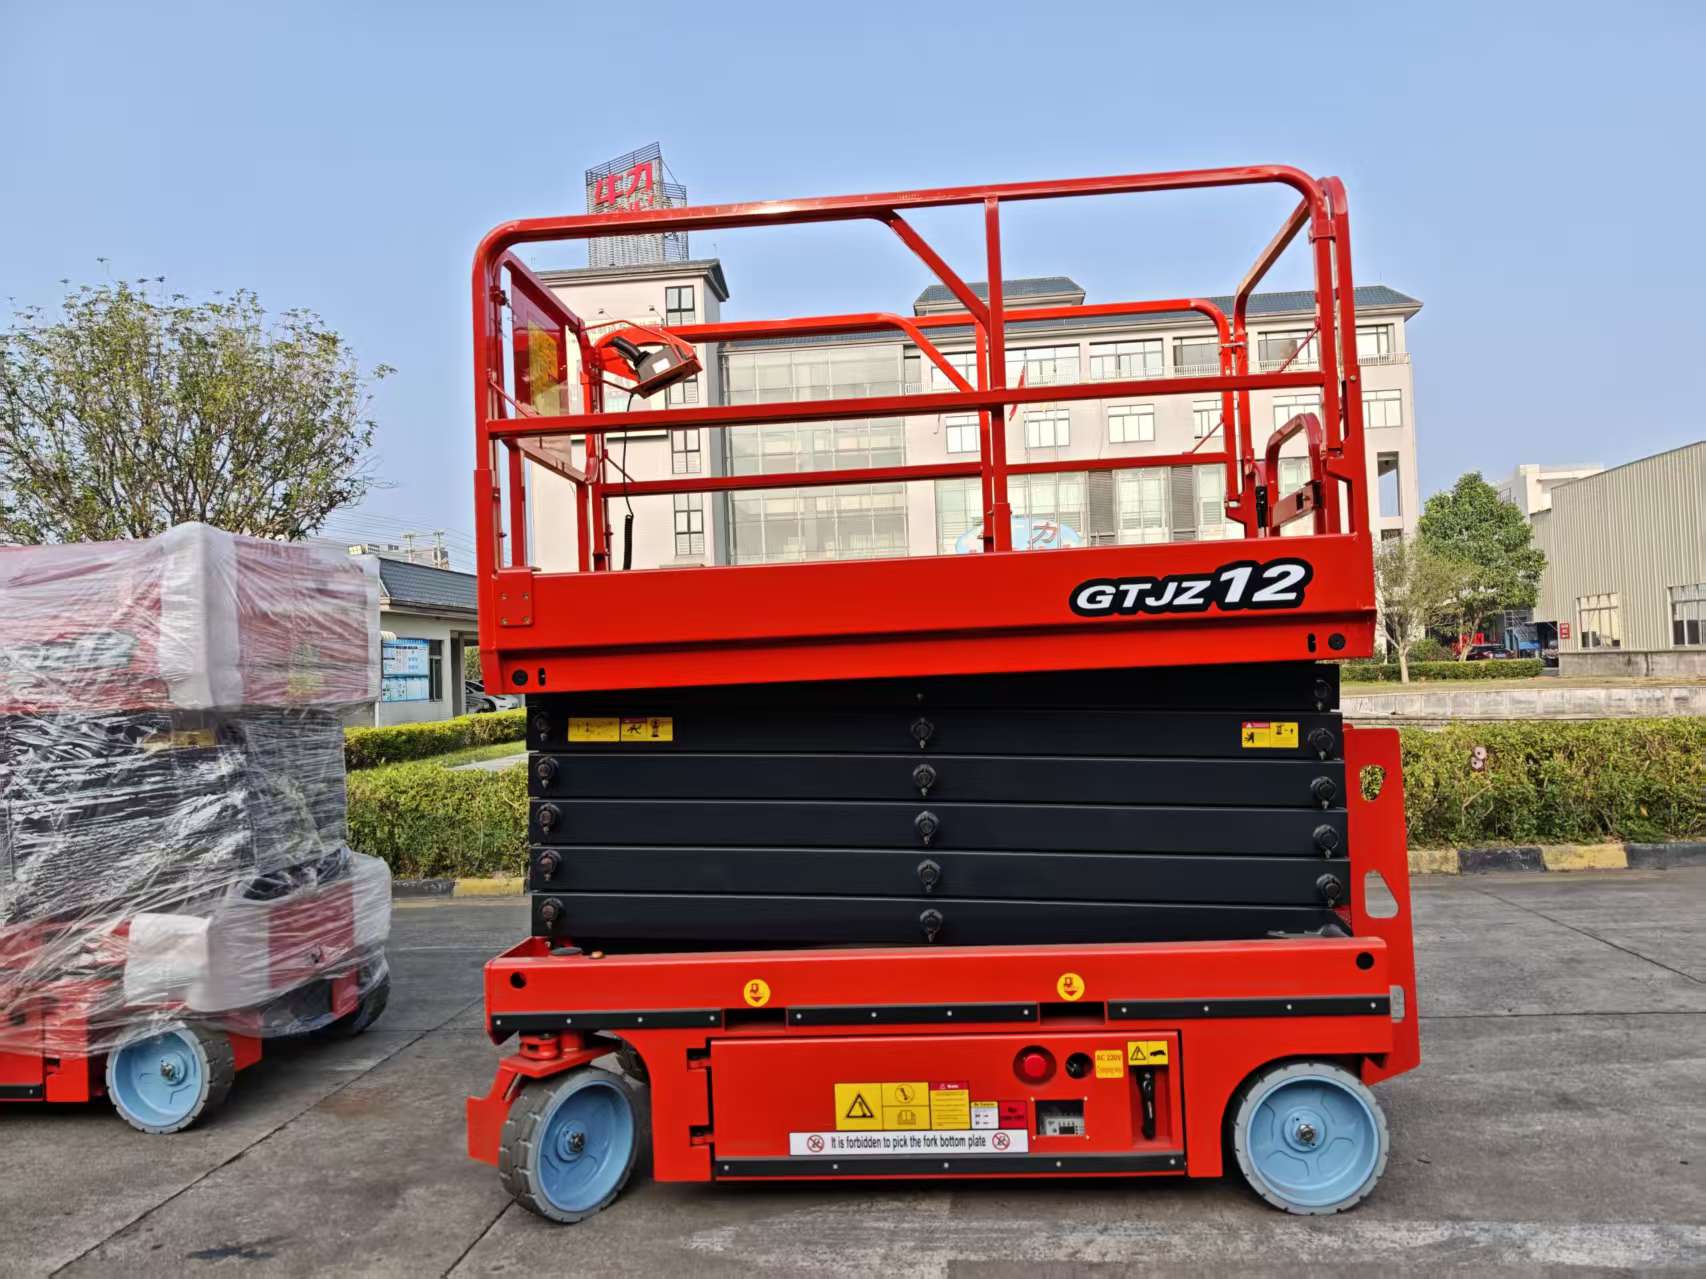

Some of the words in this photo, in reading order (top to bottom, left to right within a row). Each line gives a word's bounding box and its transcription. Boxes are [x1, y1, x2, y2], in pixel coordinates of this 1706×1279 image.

[831, 1136, 837, 1149] It
[838, 1136, 845, 1148] is
[846, 1135, 882, 1148] forbidden
[883, 1136, 891, 1148] to
[892, 1135, 908, 1151] pick
[909, 1135, 921, 1148] the
[923, 1135, 938, 1148] fork
[940, 1134, 966, 1148] bottom
[968, 1133, 986, 1149] plate
